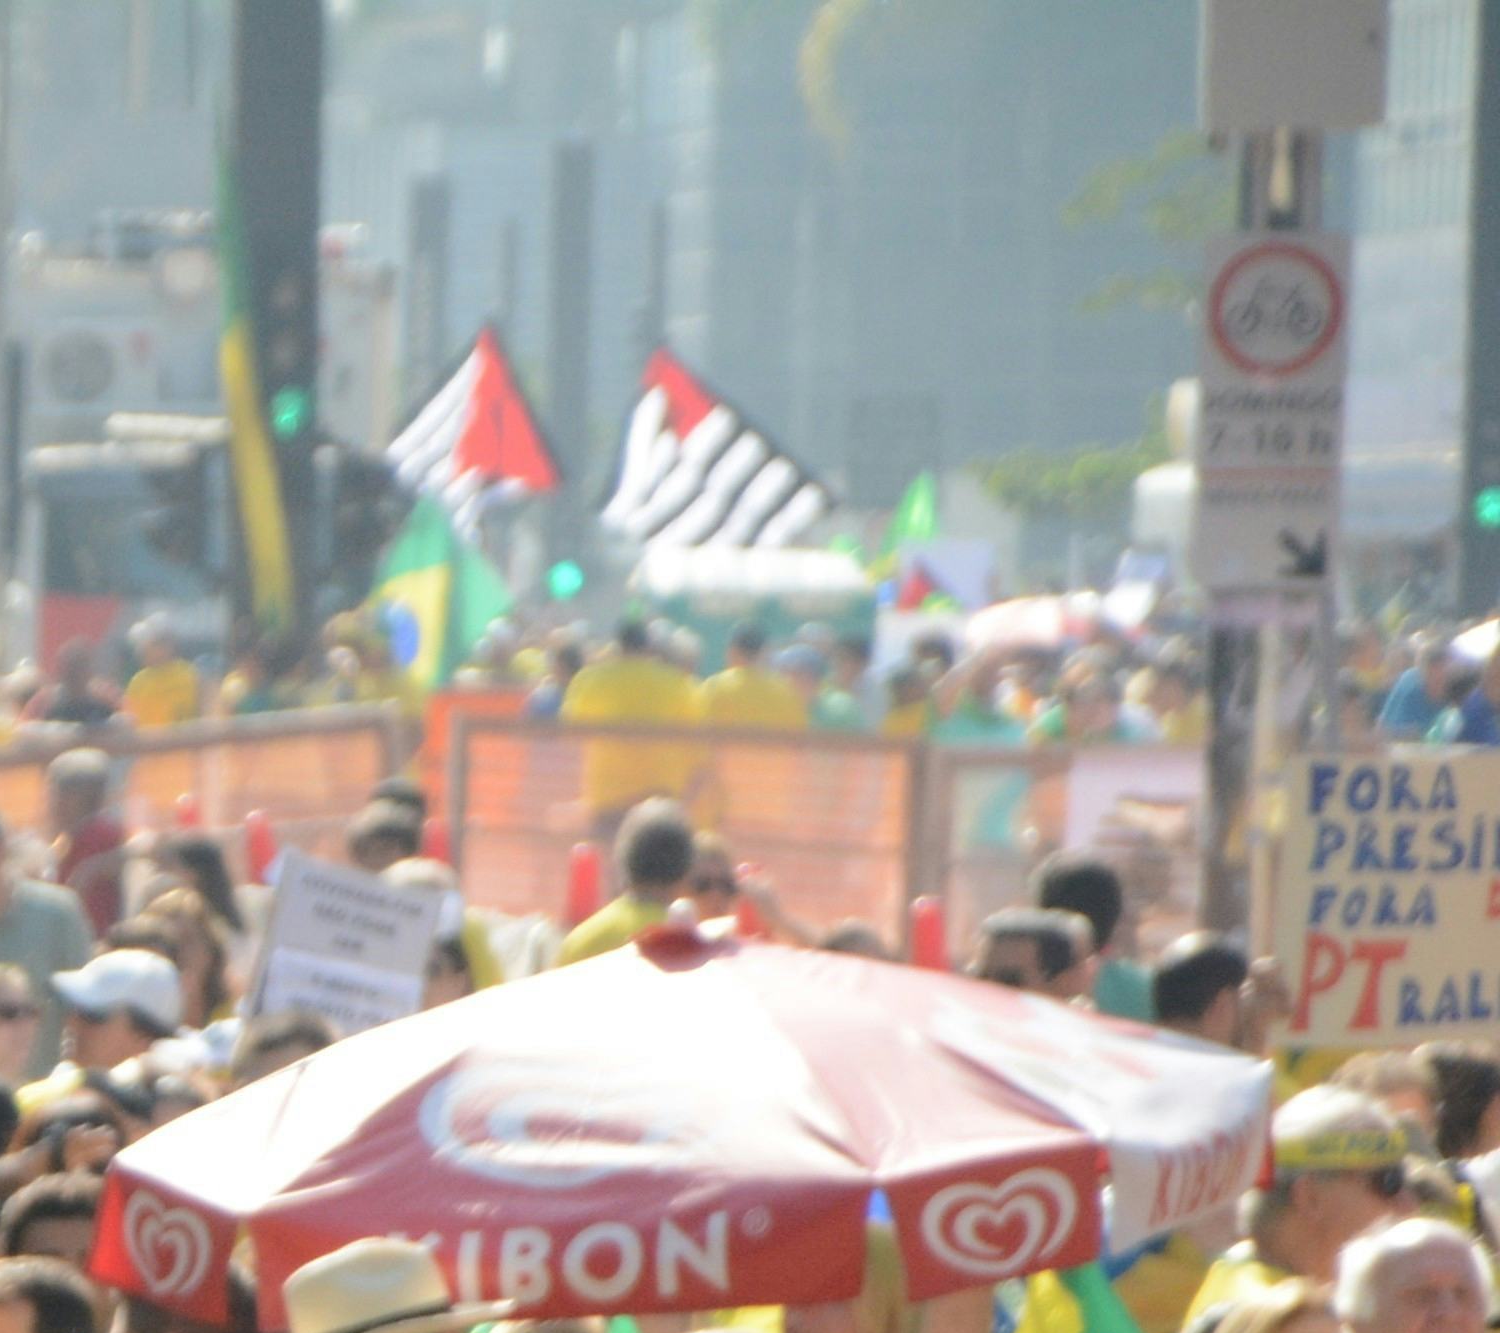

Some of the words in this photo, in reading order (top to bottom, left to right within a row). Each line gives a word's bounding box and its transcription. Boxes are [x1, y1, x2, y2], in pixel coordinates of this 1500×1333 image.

[1308, 763, 1457, 814] FORA
[1309, 814, 1500, 873] PRESI
[1307, 881, 1438, 928] FORA
[386, 1210, 733, 1307] IBON
